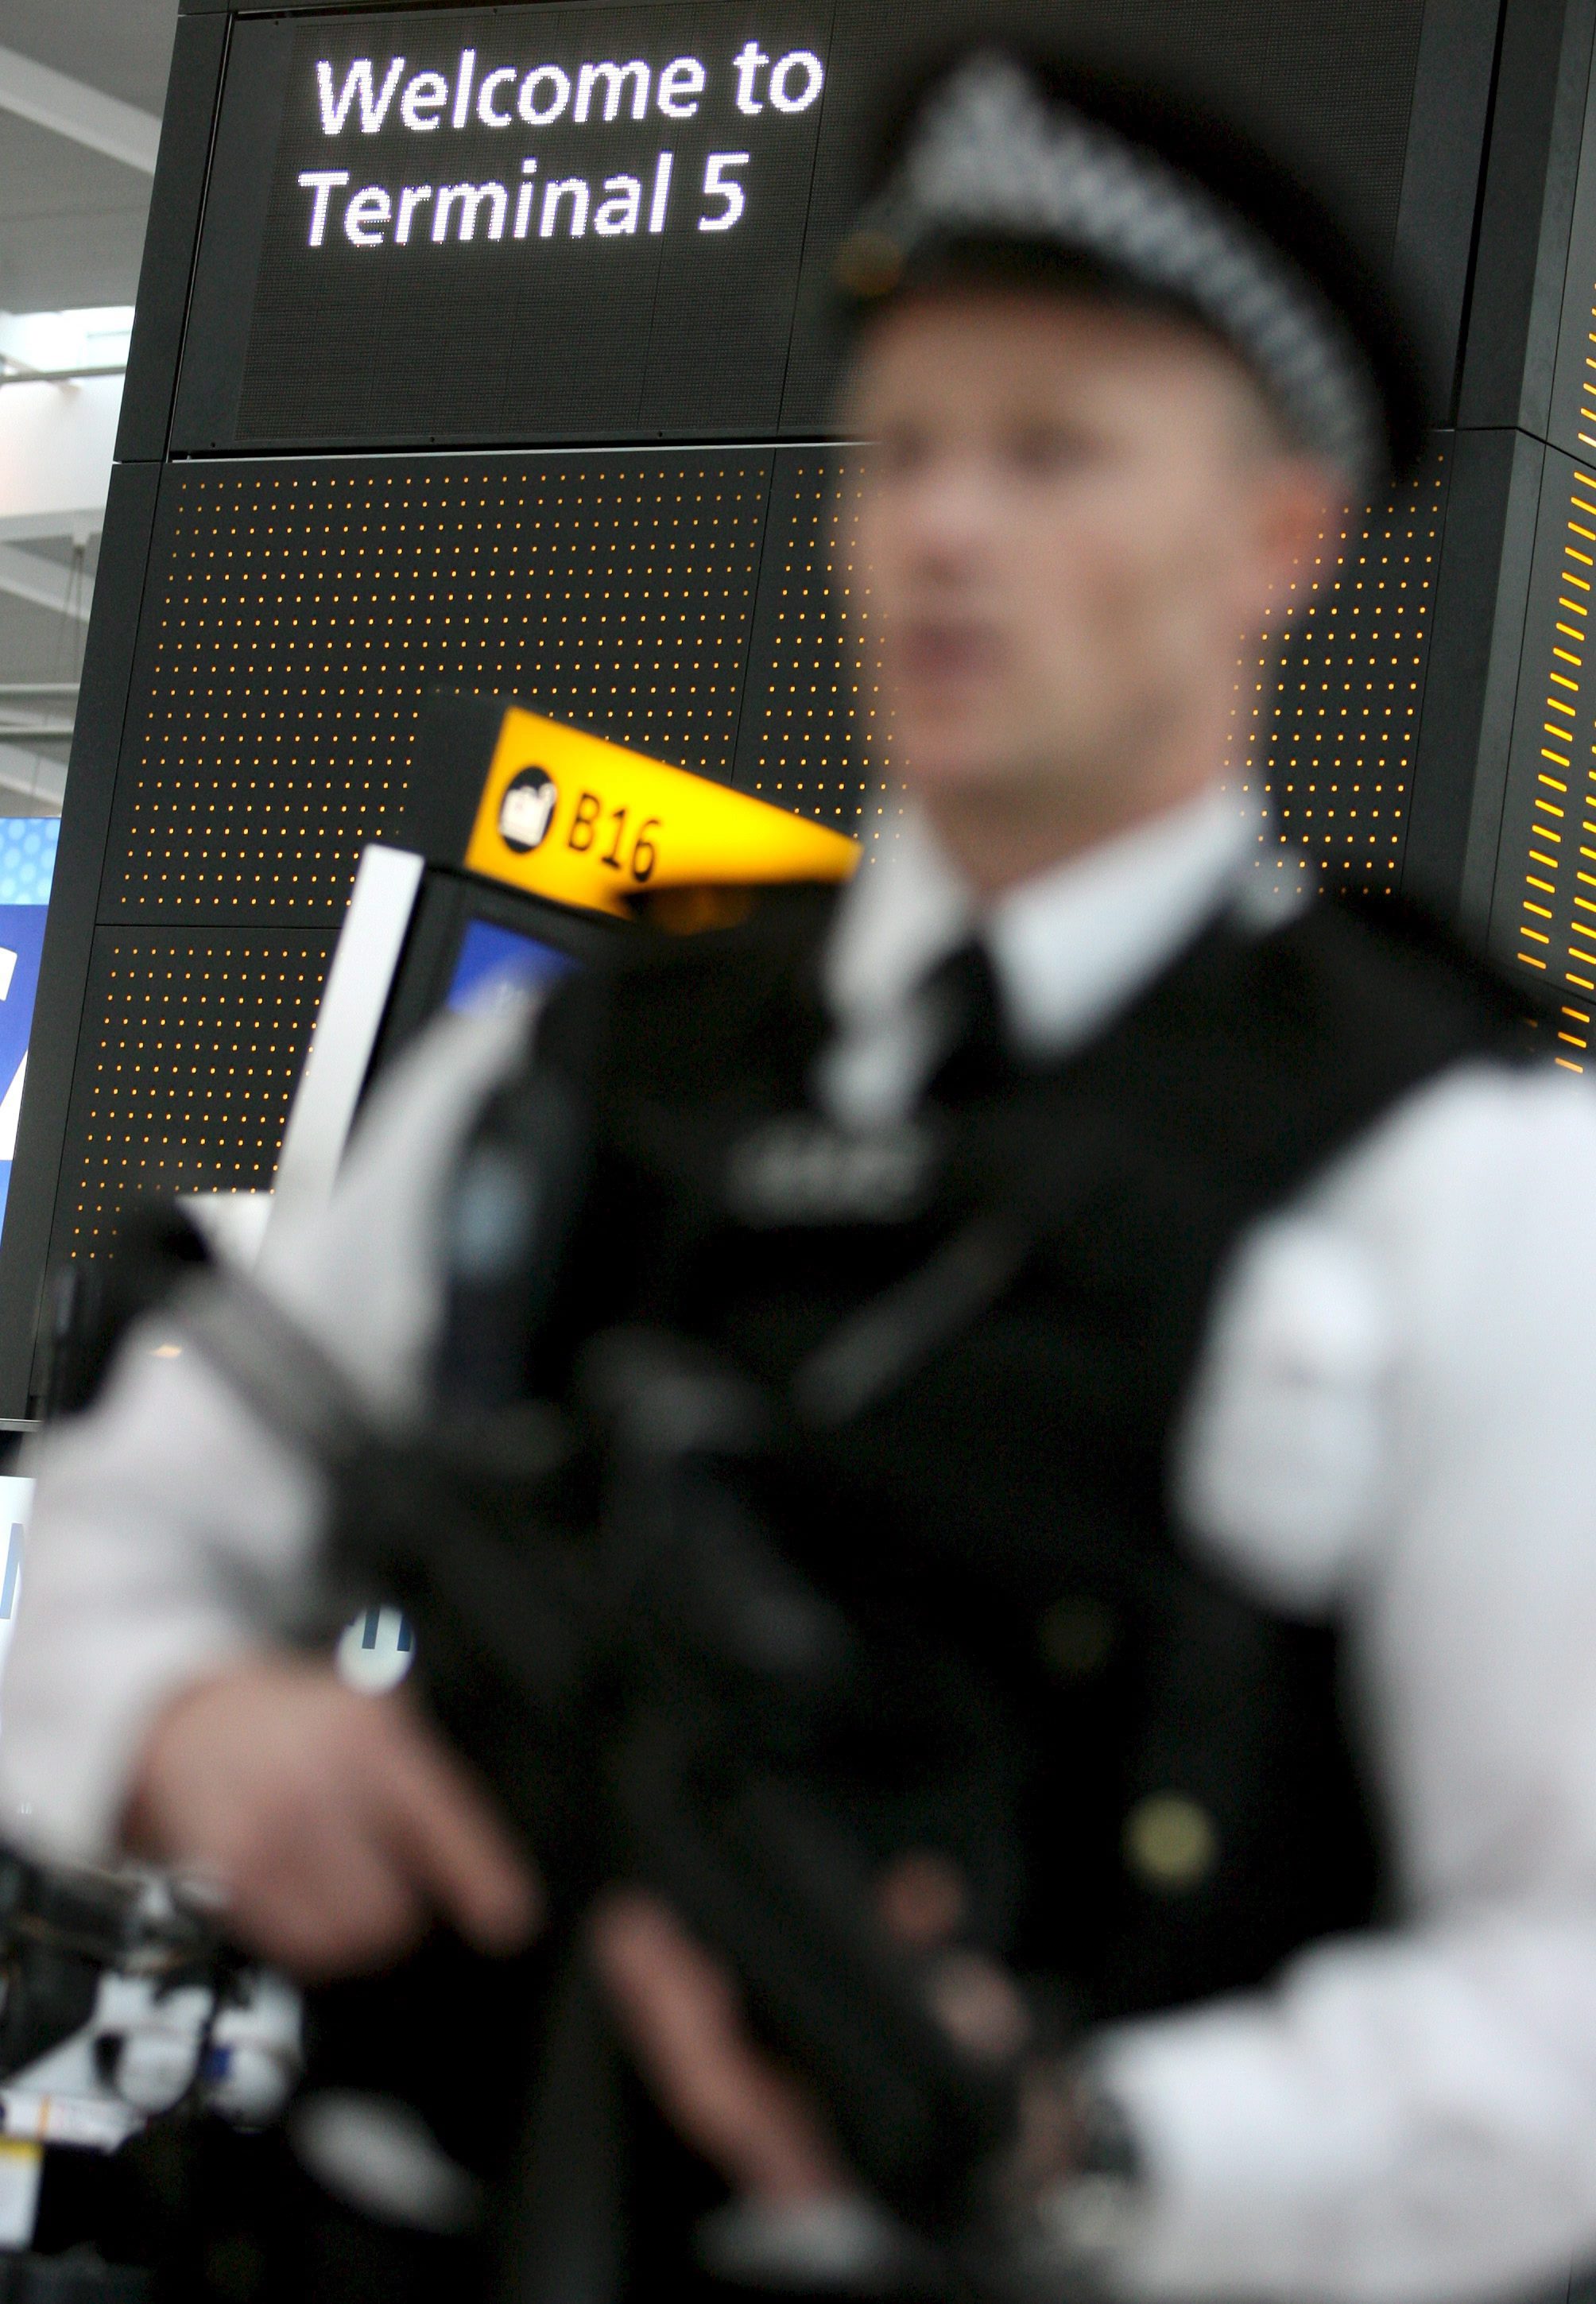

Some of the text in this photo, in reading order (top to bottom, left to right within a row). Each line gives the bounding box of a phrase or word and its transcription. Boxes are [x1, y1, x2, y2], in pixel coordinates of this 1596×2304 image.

[316, 40, 823, 134] Welcome to
[297, 151, 750, 247] Terminal 5
[567, 792, 662, 883] B16
